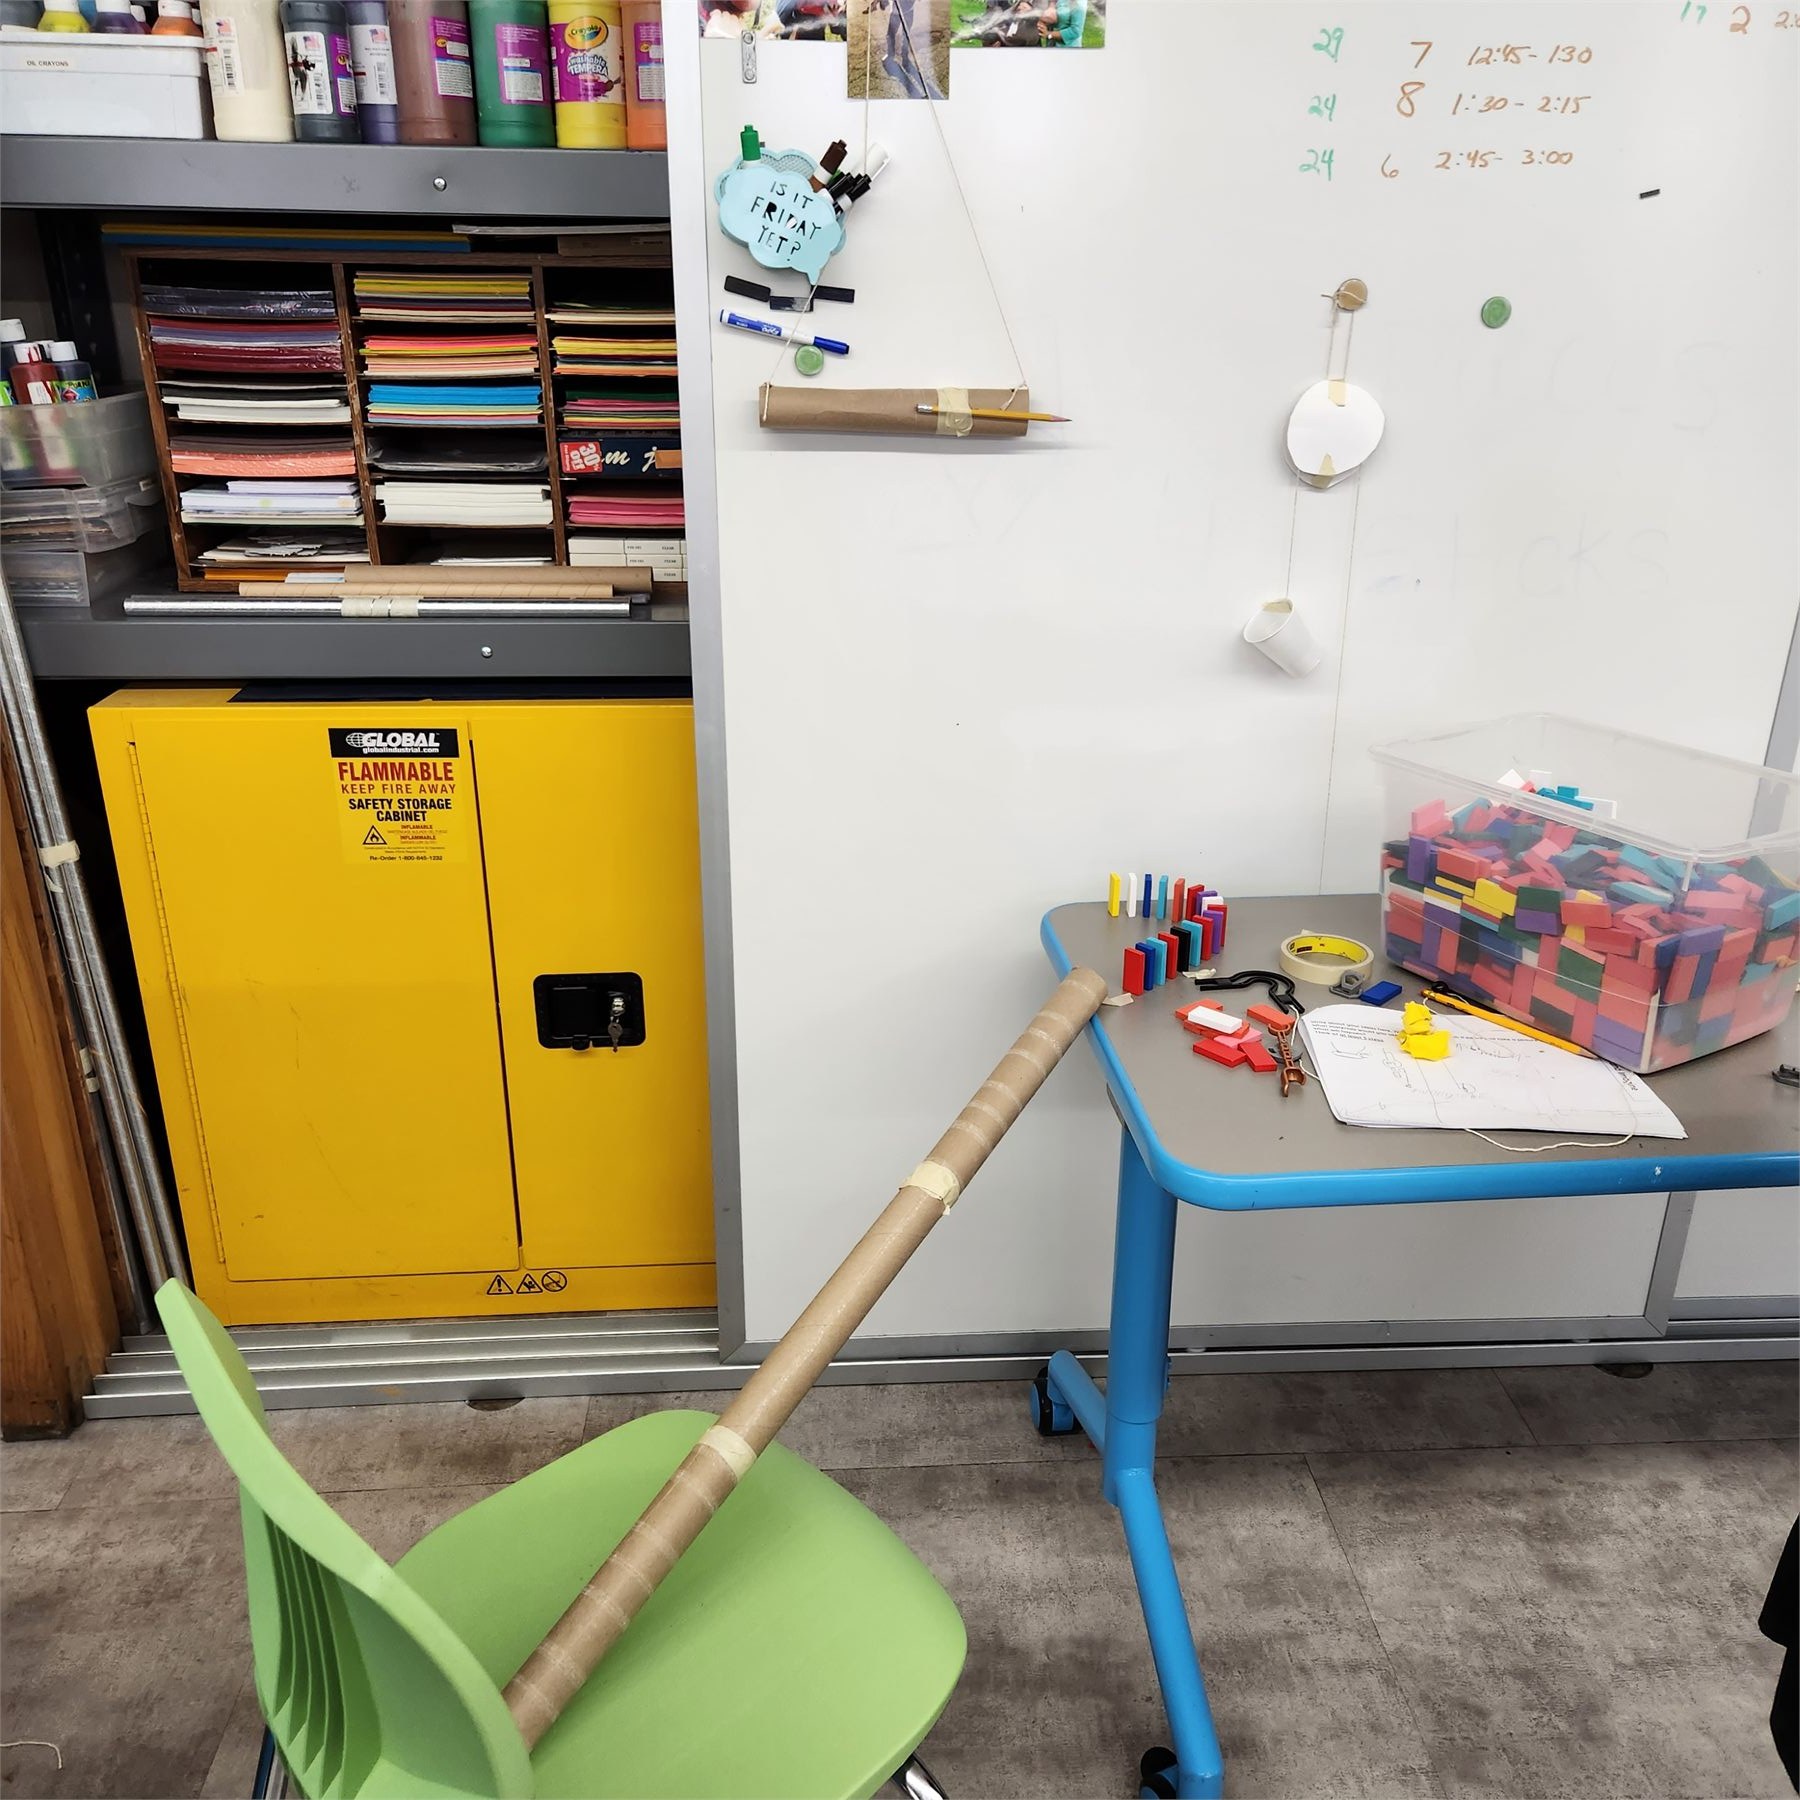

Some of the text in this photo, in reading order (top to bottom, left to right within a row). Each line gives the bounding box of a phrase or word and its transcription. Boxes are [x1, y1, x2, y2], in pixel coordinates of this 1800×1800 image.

[1729, 5, 1752, 35] 2
[1410, 41, 1433, 69] 7
[1396, 81, 1426, 118] 8
[1537, 95, 1592, 115] 2:15
[1298, 149, 1335, 182] 24
[1380, 154, 1400, 179] 6
[1521, 149, 1574, 166] 3:00
[770, 181, 813, 209] IS IT
[751, 196, 822, 240] FRIDAY
[758, 225, 802, 261] YET?
[363, 732, 440, 748] GLOBAL
[363, 747, 440, 755] globalindustrial.com
[338, 762, 454, 781] FLAMMABLE
[341, 783, 456, 794] KEEP FIRE AWAY
[348, 798, 452, 810] SAFETY STORAGE
[376, 810, 427, 822] CABINET
